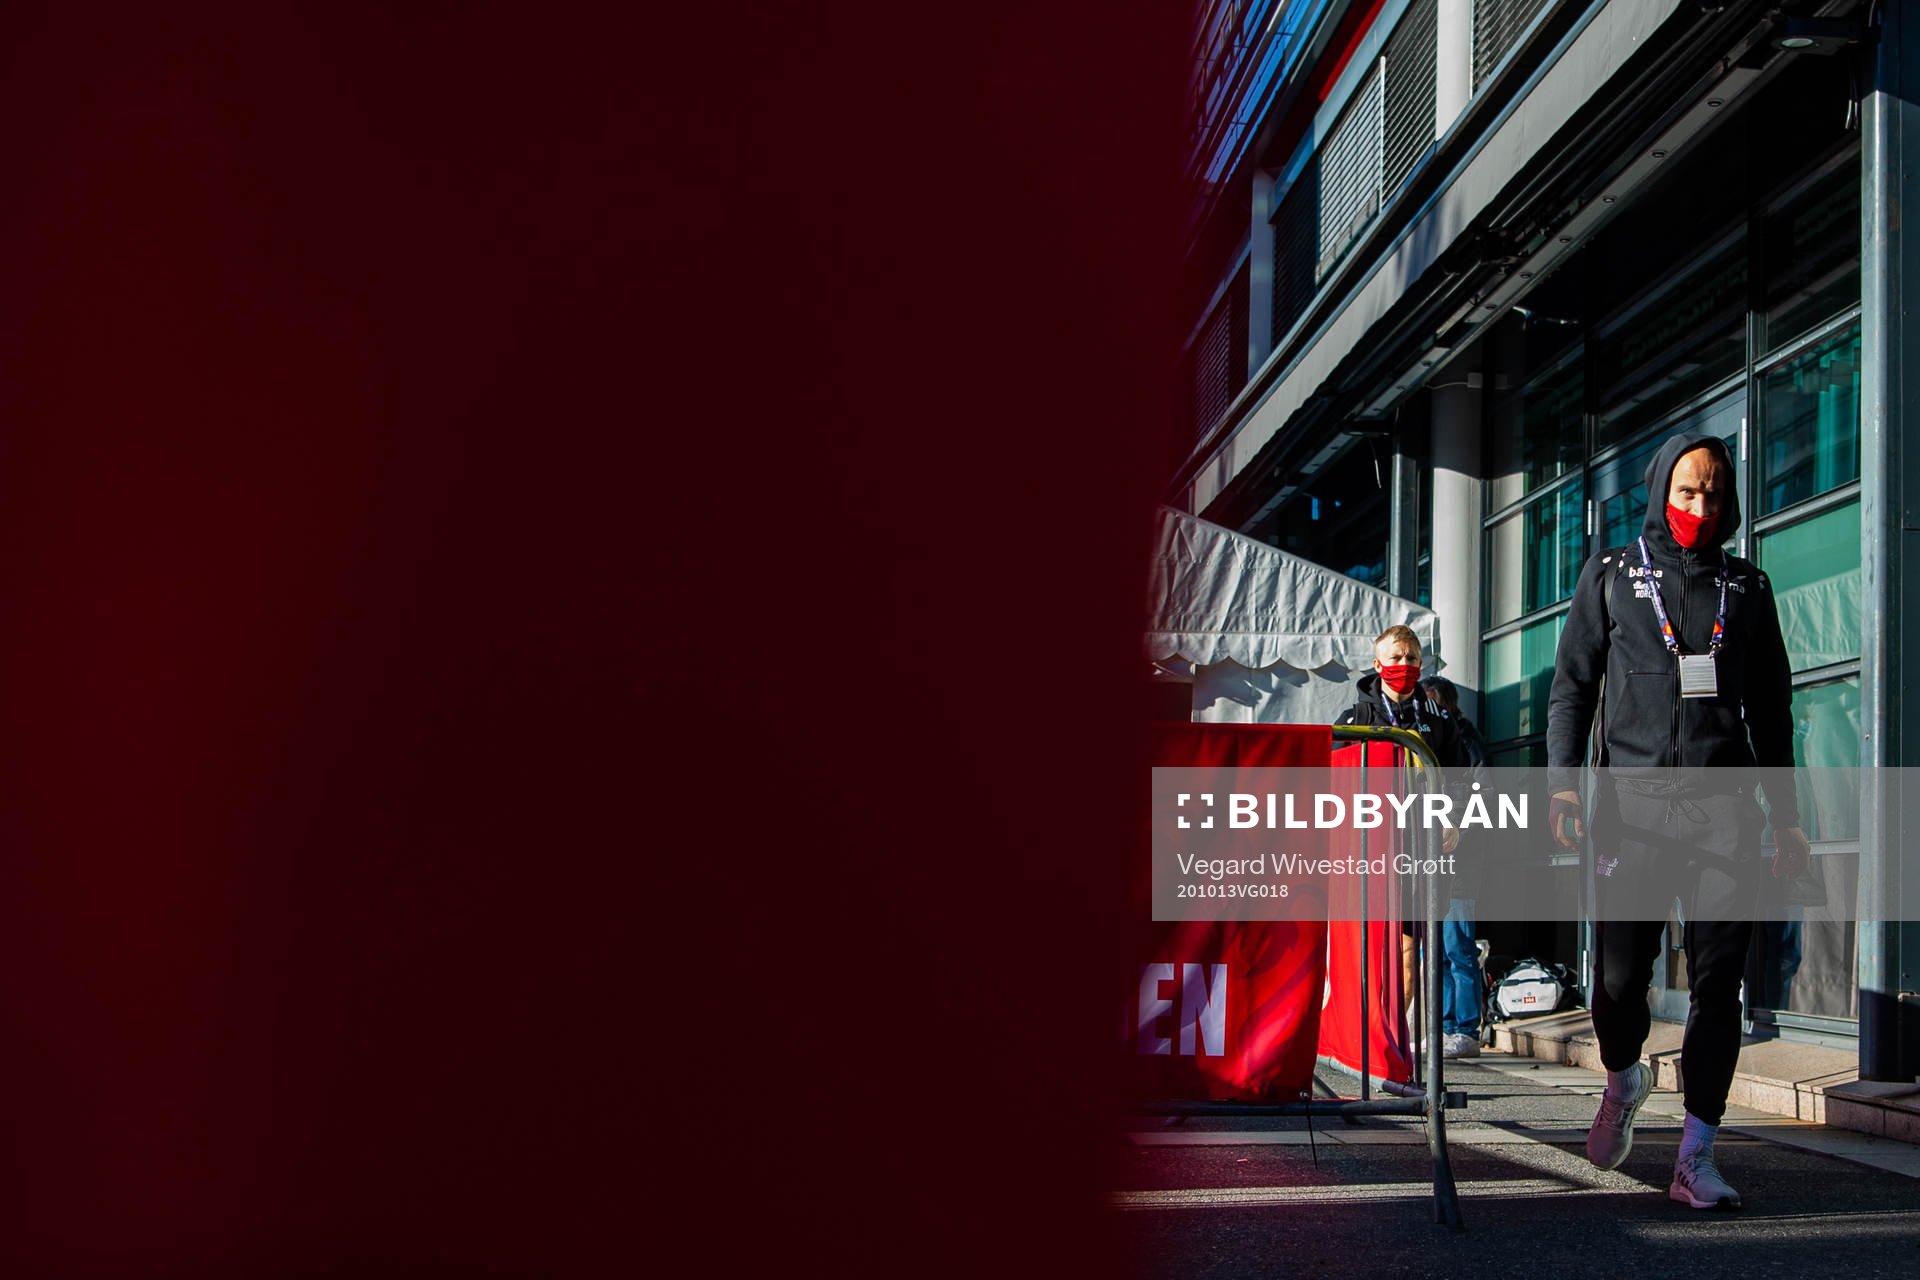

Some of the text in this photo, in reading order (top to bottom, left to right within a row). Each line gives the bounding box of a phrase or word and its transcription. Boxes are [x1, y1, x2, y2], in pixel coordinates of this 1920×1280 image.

[1628, 567, 1663, 578] baa
[1714, 577, 1745, 594] bma
[1134, 963, 1228, 1057] EN
